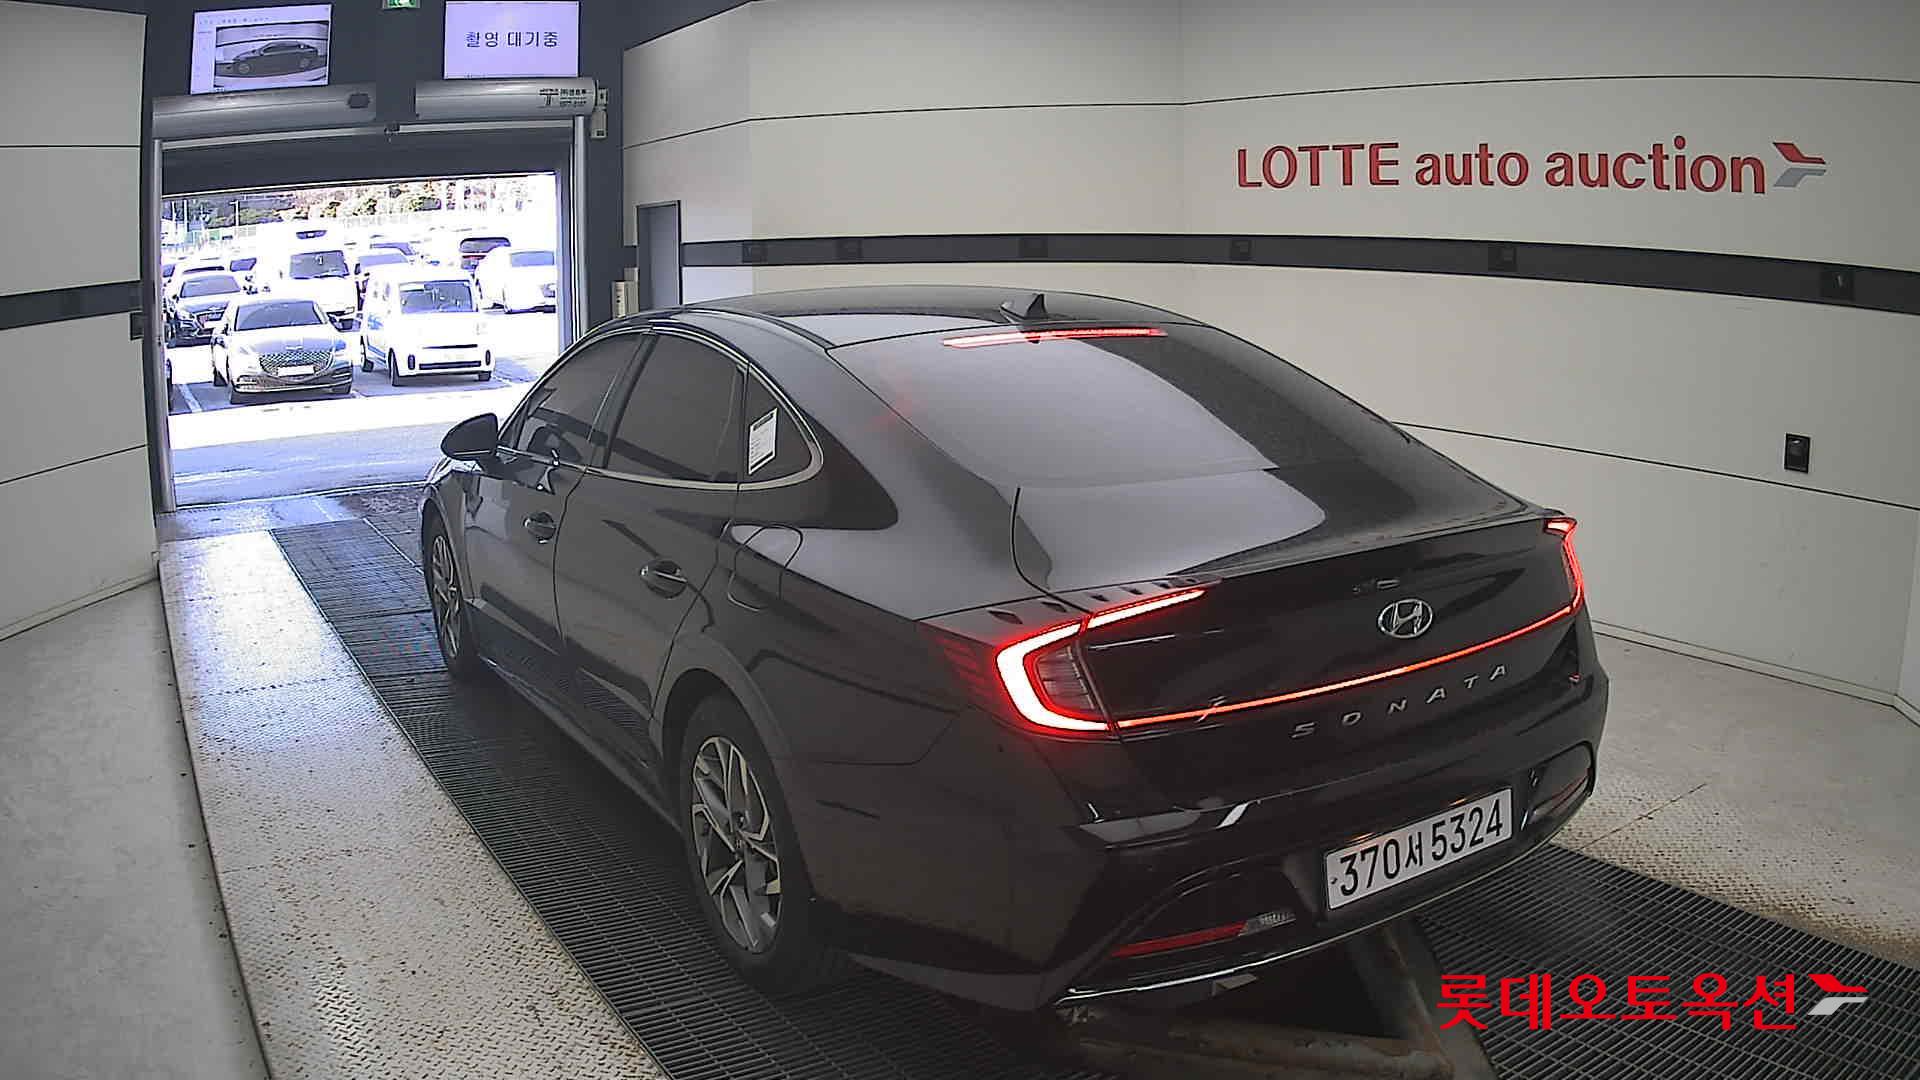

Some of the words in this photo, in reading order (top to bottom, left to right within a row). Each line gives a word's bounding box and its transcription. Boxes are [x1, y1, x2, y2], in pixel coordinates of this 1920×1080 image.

[507, 31, 558, 48] 대기중
[1237, 142, 1400, 189] LOTTE
[1414, 143, 1529, 186] auto
[1545, 135, 1766, 195] auction
[1291, 664, 1508, 738] SONATA
